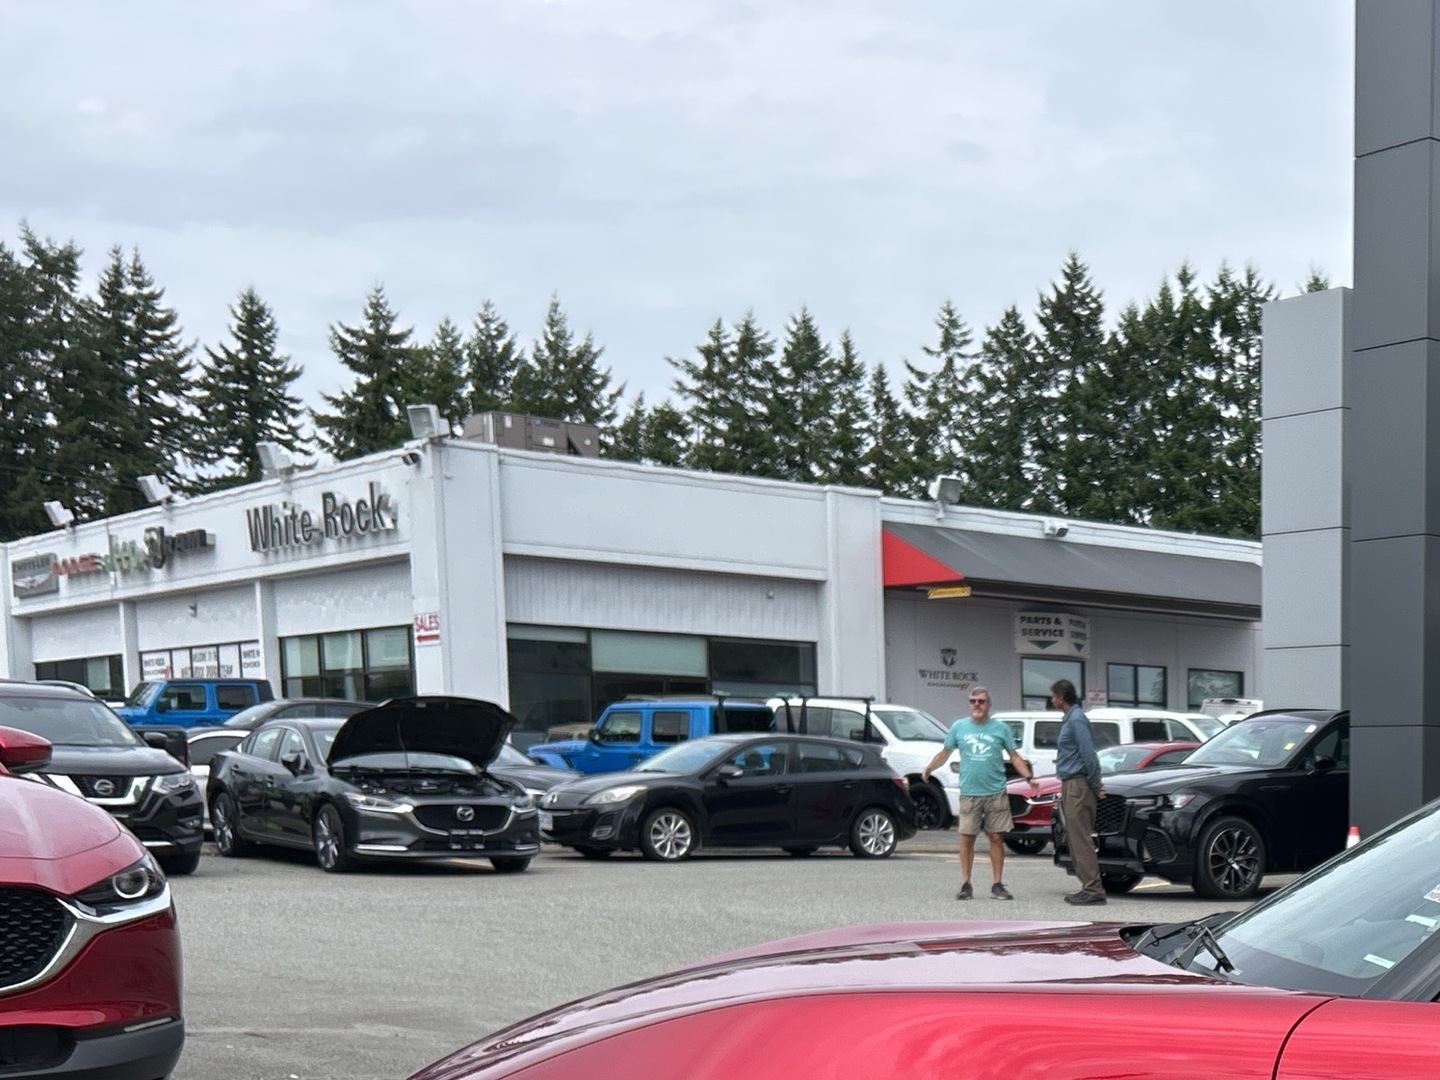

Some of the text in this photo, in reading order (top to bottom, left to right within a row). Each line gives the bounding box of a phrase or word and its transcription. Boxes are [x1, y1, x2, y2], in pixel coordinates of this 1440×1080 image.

[246, 481, 395, 551] White Rock
[413, 612, 440, 632] SALES
[1019, 615, 1062, 626] PARTS &
[1021, 628, 1065, 638] SERVICE
[918, 669, 979, 682] WHITE ROCK
